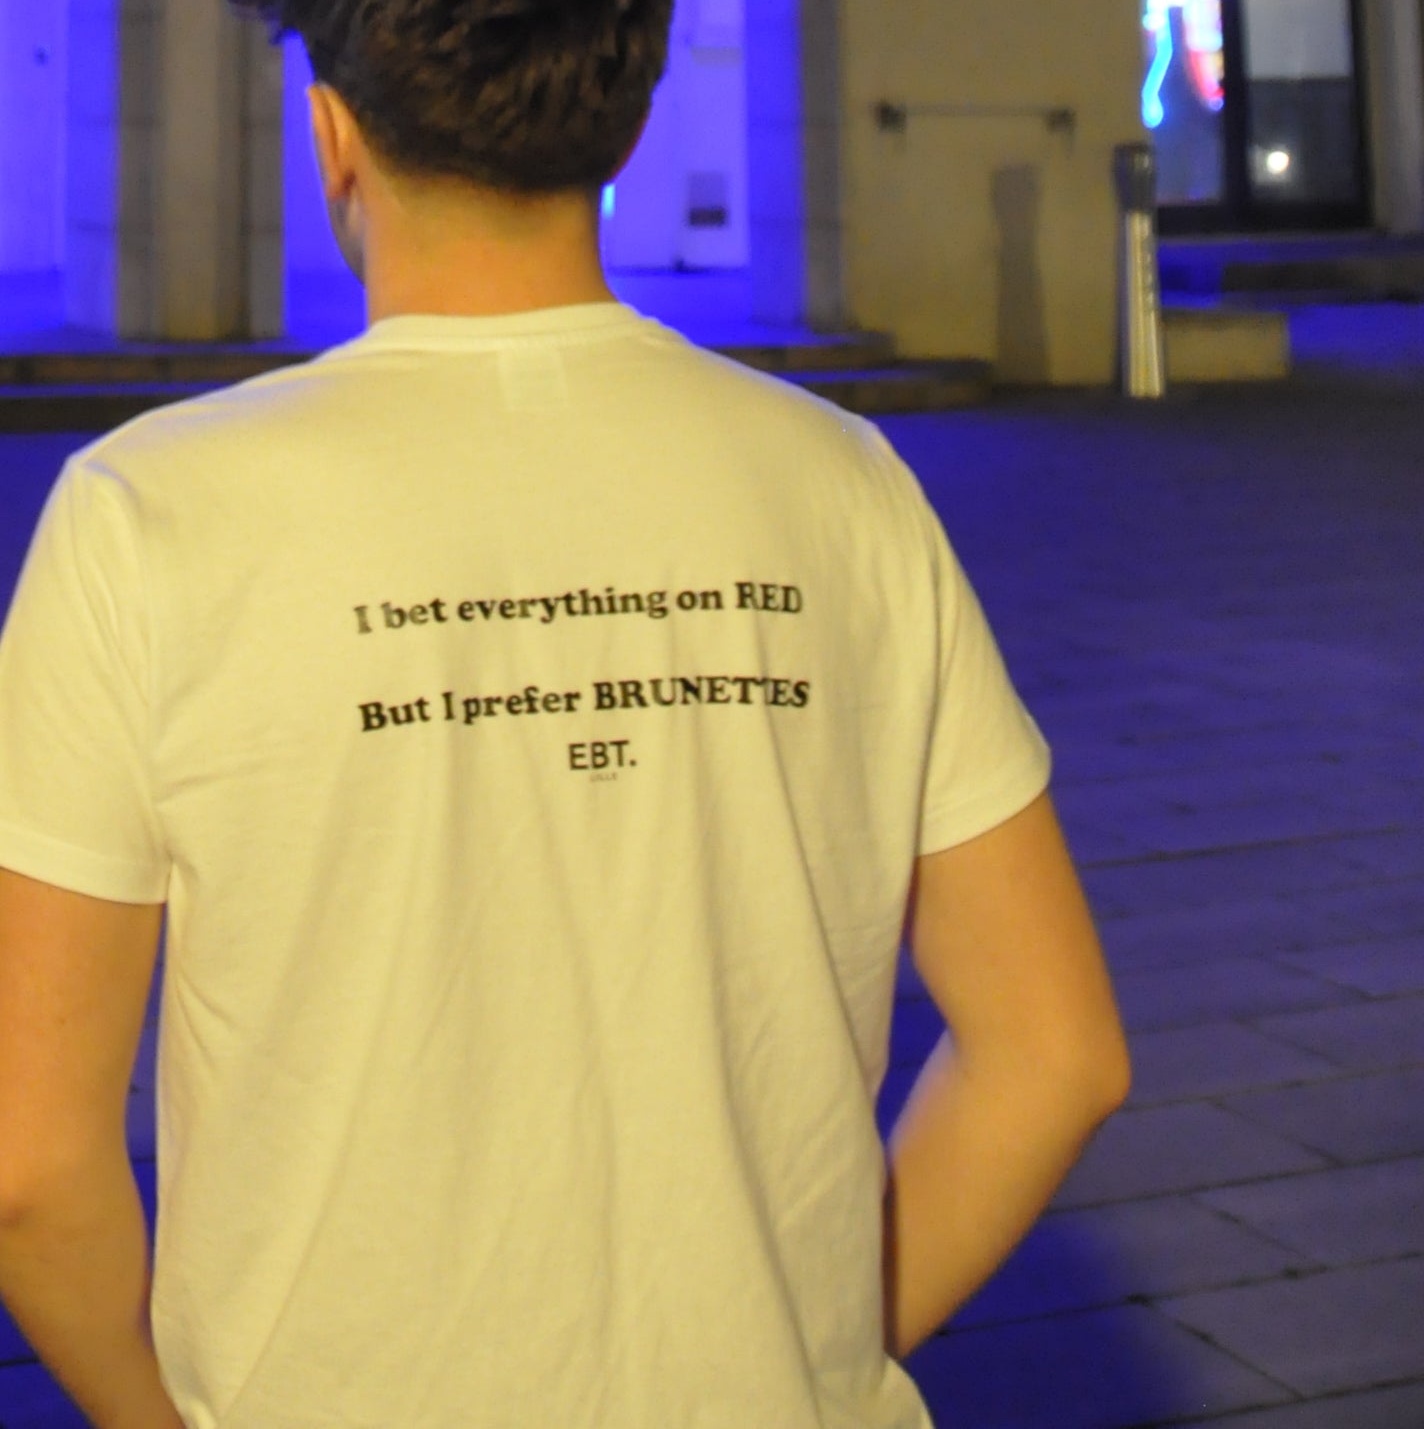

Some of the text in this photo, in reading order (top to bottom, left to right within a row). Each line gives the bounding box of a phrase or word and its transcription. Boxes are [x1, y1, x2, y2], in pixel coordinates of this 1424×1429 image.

[353, 581, 803, 634] I bet everything on RED
[358, 697, 432, 733] But
[442, 691, 454, 722] I
[462, 686, 582, 726] prefer
[568, 740, 638, 771] EBT.
